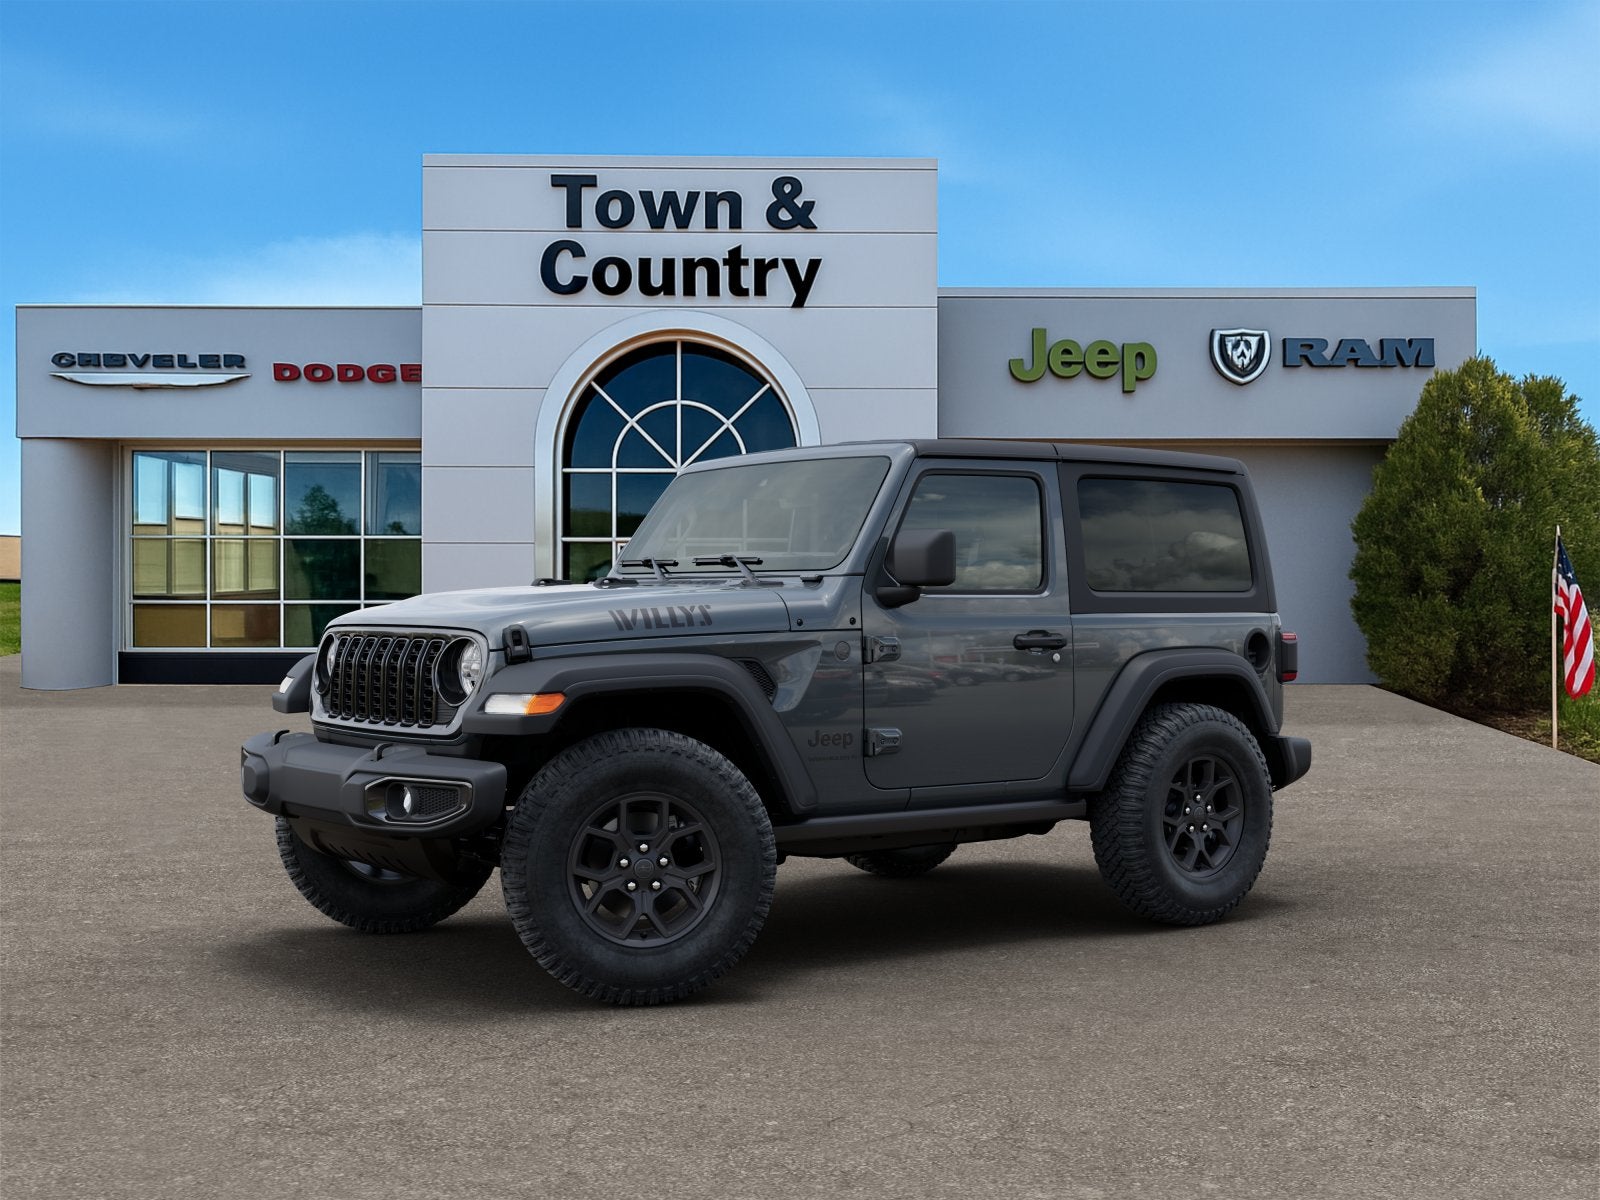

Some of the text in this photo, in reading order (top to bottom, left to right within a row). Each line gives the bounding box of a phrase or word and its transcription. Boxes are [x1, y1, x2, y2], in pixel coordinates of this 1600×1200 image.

[550, 174, 818, 230] Town &
[540, 239, 823, 308] Country
[1008, 328, 1157, 393] Jeep
[1282, 337, 1435, 368] RAM
[272, 362, 422, 383] DODGE
[608, 604, 713, 631] WILLYS
[807, 729, 854, 749] Jeep
